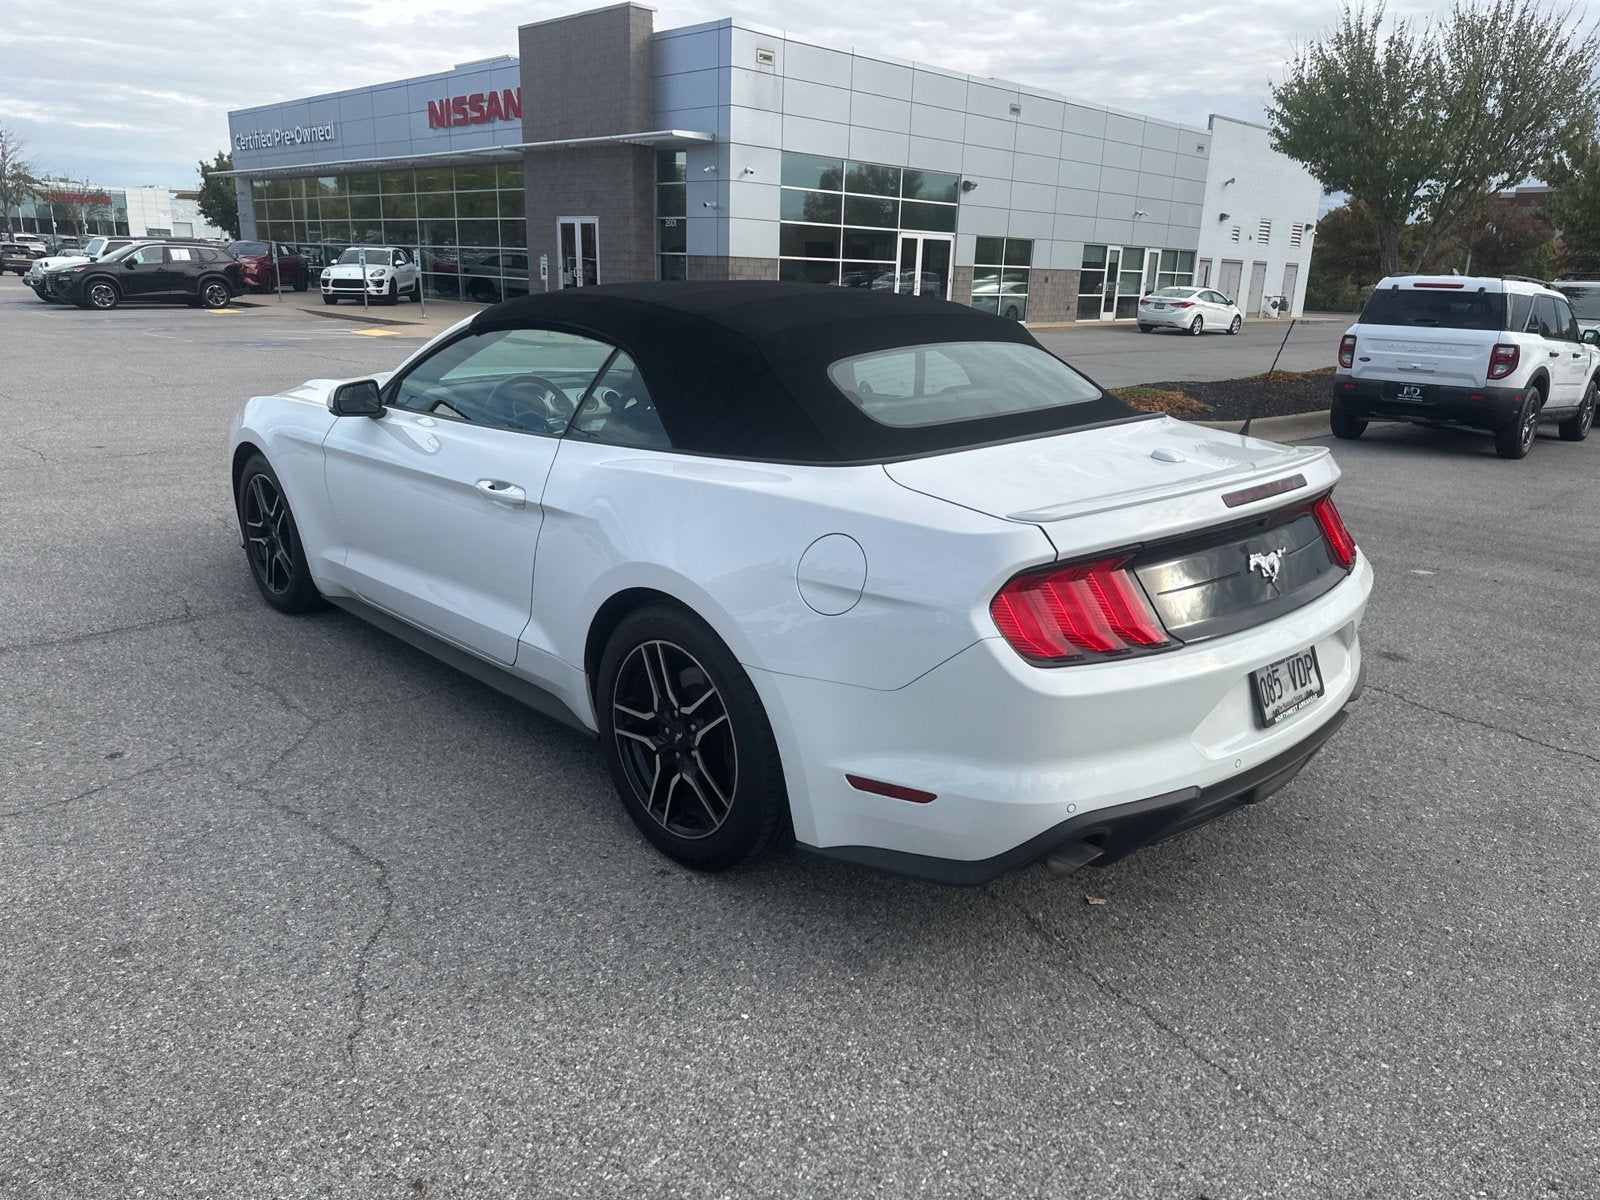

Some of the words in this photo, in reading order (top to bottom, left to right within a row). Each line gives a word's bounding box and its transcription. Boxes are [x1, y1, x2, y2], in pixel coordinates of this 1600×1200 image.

[427, 87, 522, 129] NISSAN
[234, 128, 274, 151] Certified
[274, 119, 335, 147] Pre-Owned
[1260, 668, 1283, 708] 085
[1287, 653, 1314, 691] VDP
